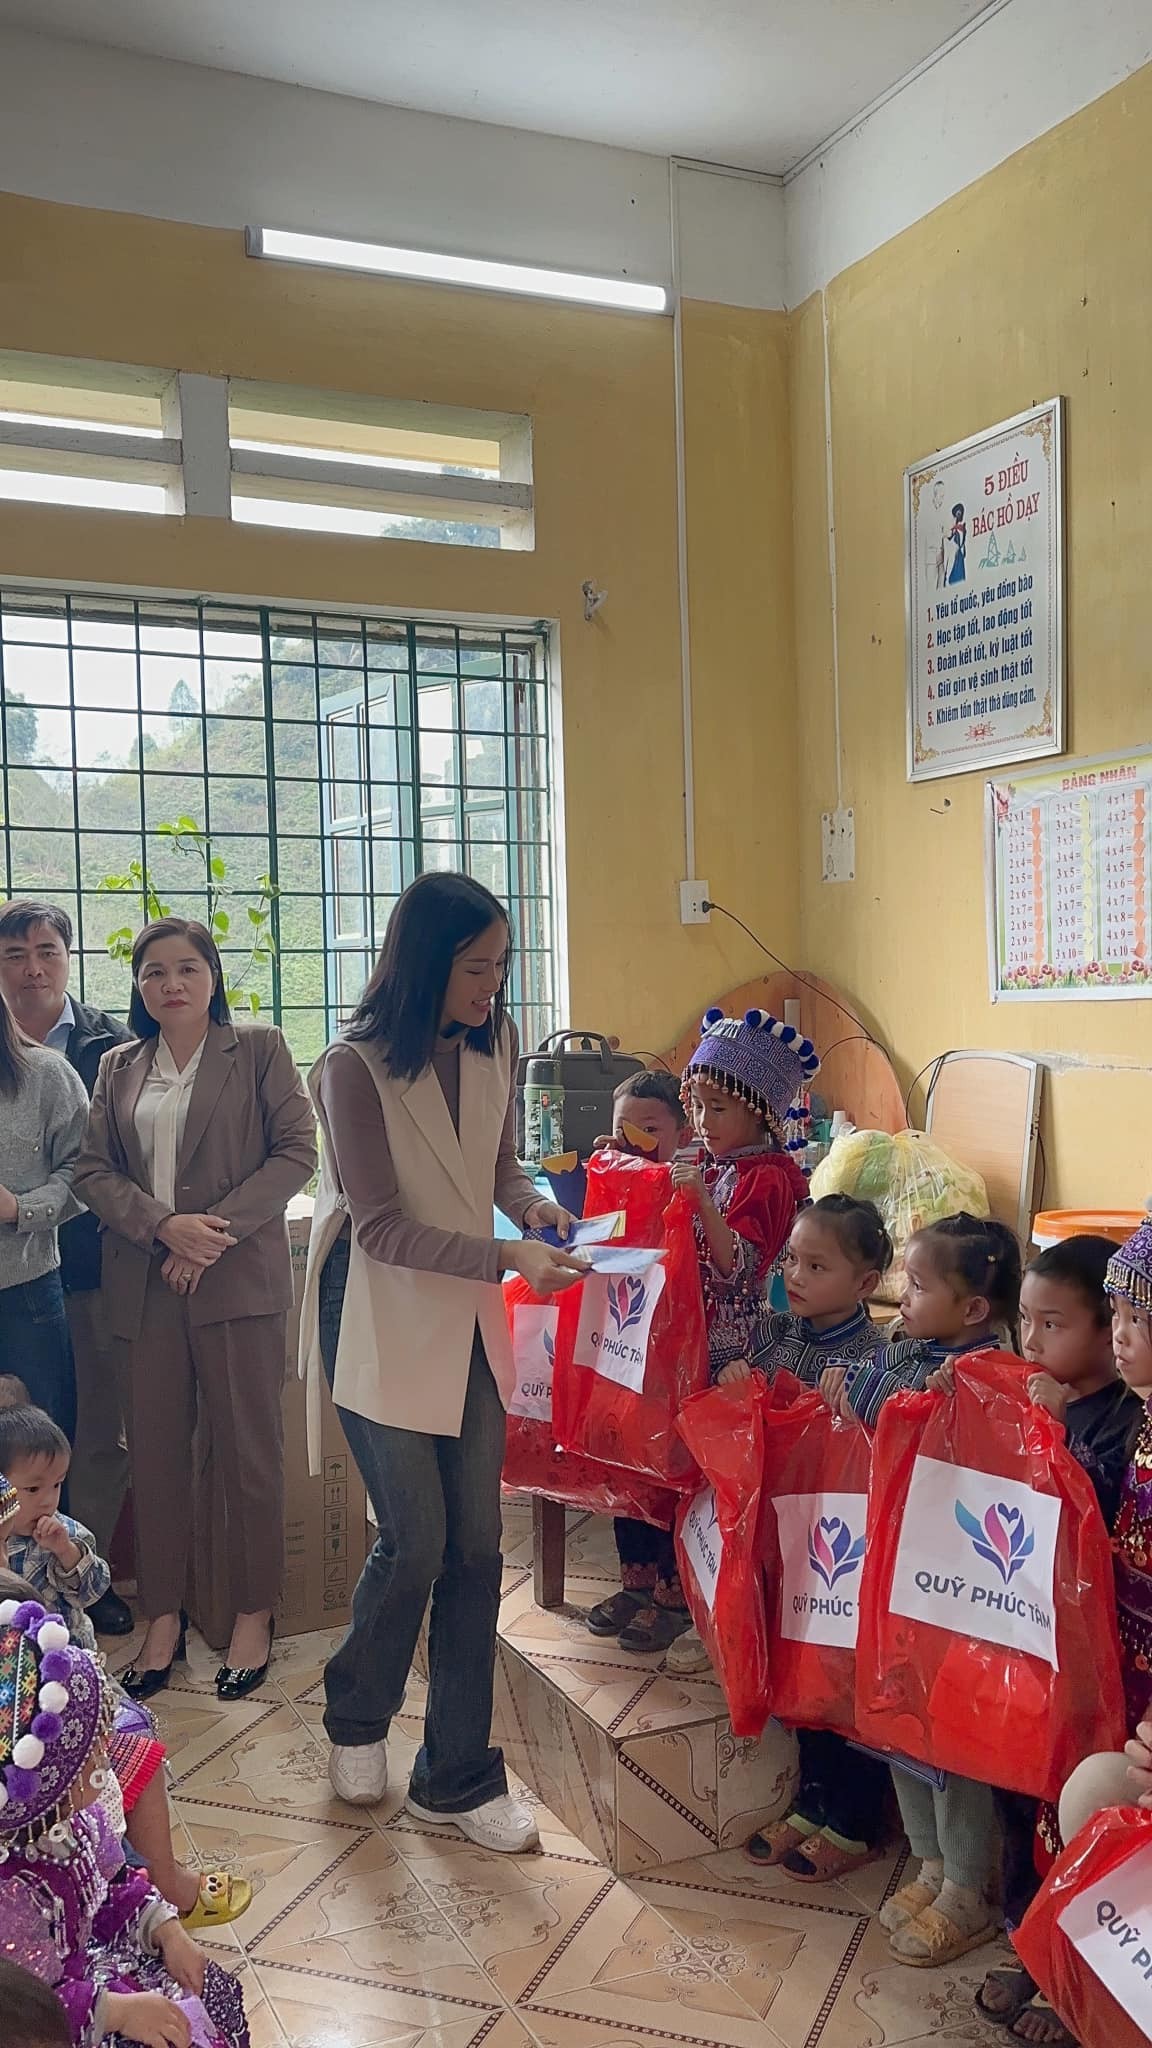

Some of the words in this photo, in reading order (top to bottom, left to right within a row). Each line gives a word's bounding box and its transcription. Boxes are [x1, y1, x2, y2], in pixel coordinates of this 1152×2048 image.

[984, 474, 994, 496] 5
[998, 452, 1029, 492] ĐIỀU
[972, 507, 994, 538] BÁC
[997, 492, 1014, 528] HỒ
[1016, 492, 1040, 520] DẠY
[928, 608, 934, 622] 1.
[936, 602, 949, 620] Yêu
[950, 594, 958, 616] tổ
[960, 590, 980, 614] quốc,
[982, 587, 994, 607] yêu
[998, 578, 1016, 600] đồng
[927, 633, 934, 648] 2.
[937, 630, 951, 648] Học
[953, 624, 965, 643] tập
[983, 616, 995, 632] lao
[998, 608, 1018, 629] động
[1021, 598, 1032, 620] tốt
[928, 660, 934, 675] 3.
[937, 653, 957, 672] Đoàn
[960, 645, 972, 666] kết
[1002, 634, 1019, 655] luật
[1021, 626, 1032, 648] tốt
[928, 685, 935, 700] 4.
[938, 678, 951, 698] Giữ
[968, 672, 978, 692] vệ
[980, 667, 999, 686] sinh
[1001, 662, 1018, 682] thật
[1021, 654, 1033, 676] tốt
[928, 712, 934, 726] 5.
[936, 706, 958, 725] Khiêm
[960, 699, 972, 719] tốn
[974, 697, 987, 718] thật
[1002, 691, 1018, 709] dũng
[1062, 772, 1096, 790] BẢNG
[1100, 765, 1136, 783] NHÂN
[603, 1338, 628, 1359] PHÚC
[521, 1382, 545, 1397] QUỸ
[792, 1592, 808, 1614] QUỸ
[810, 1595, 853, 1617] PHÚC
[915, 1571, 966, 1598] QUỸ
[970, 1586, 1026, 1618] PHÚC
[1028, 1604, 1052, 1632] TÂM
[1096, 1900, 1141, 1948] QUỸ
